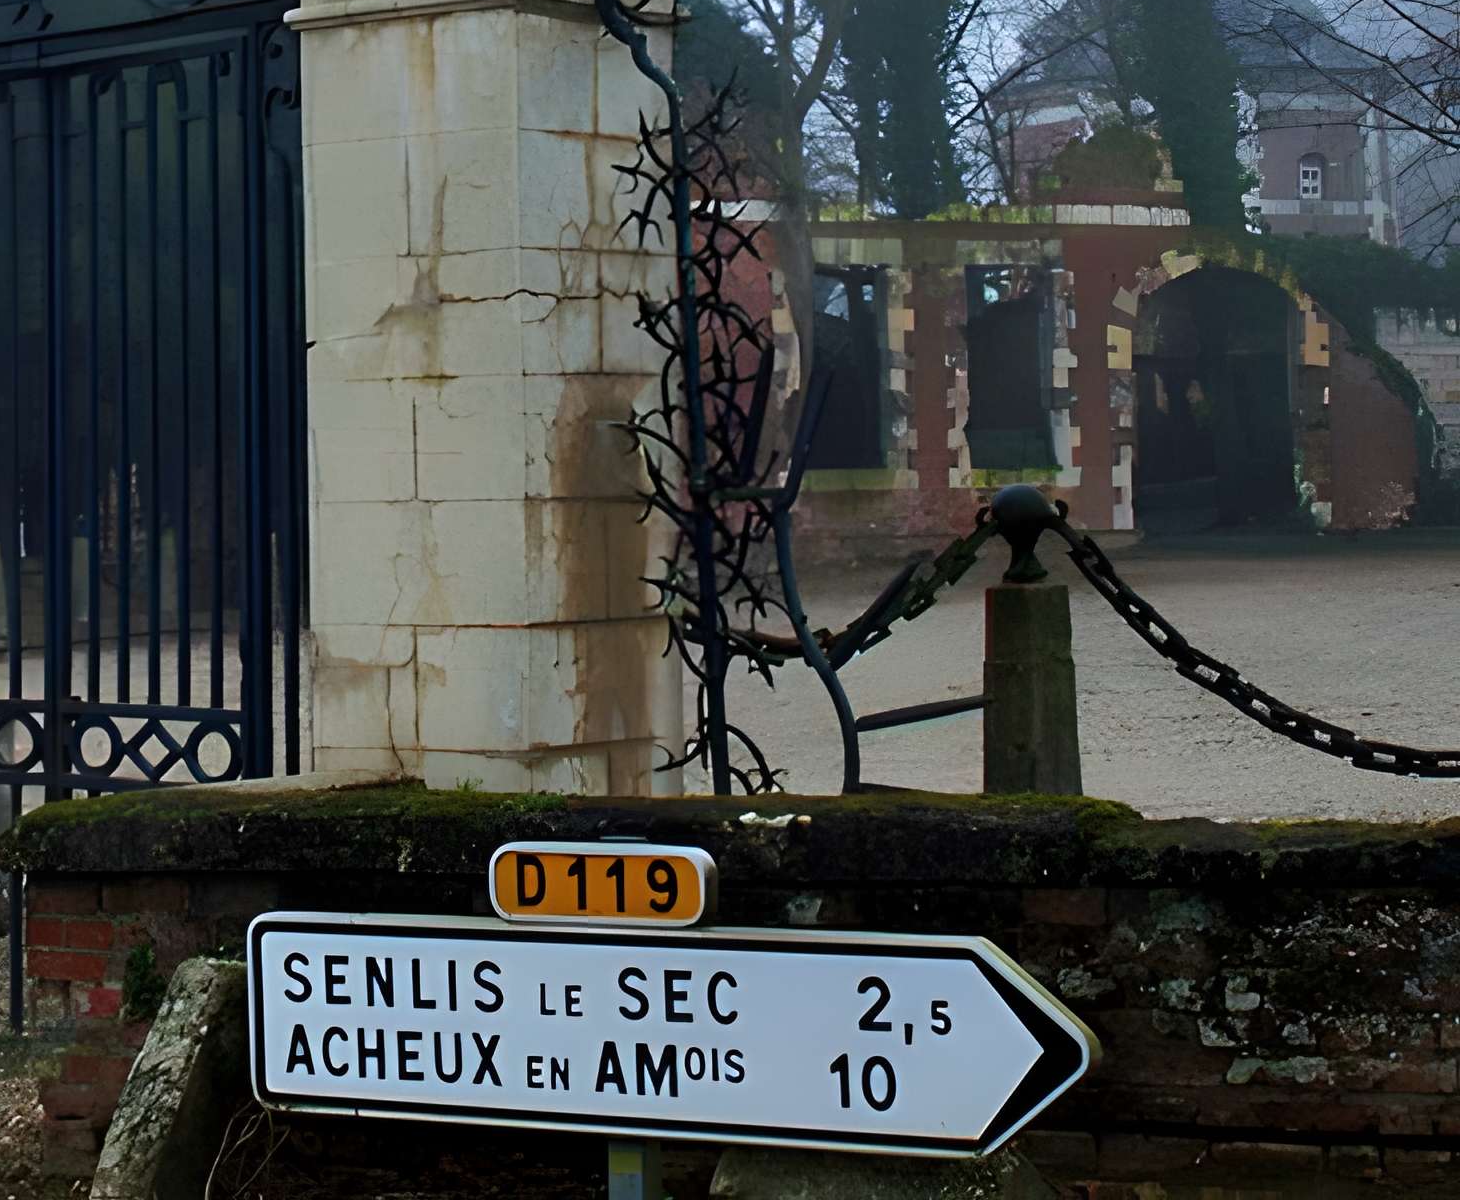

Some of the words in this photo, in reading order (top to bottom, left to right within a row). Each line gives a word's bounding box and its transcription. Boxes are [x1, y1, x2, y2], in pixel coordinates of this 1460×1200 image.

[282, 951, 506, 1015] SENLIS
[538, 981, 585, 1019] LE
[616, 965, 741, 1027] SEC
[855, 974, 953, 1047] 2,5
[284, 1022, 504, 1089] ACHEUX
[525, 1054, 571, 1092] EN
[828, 1051, 898, 1113] 10
